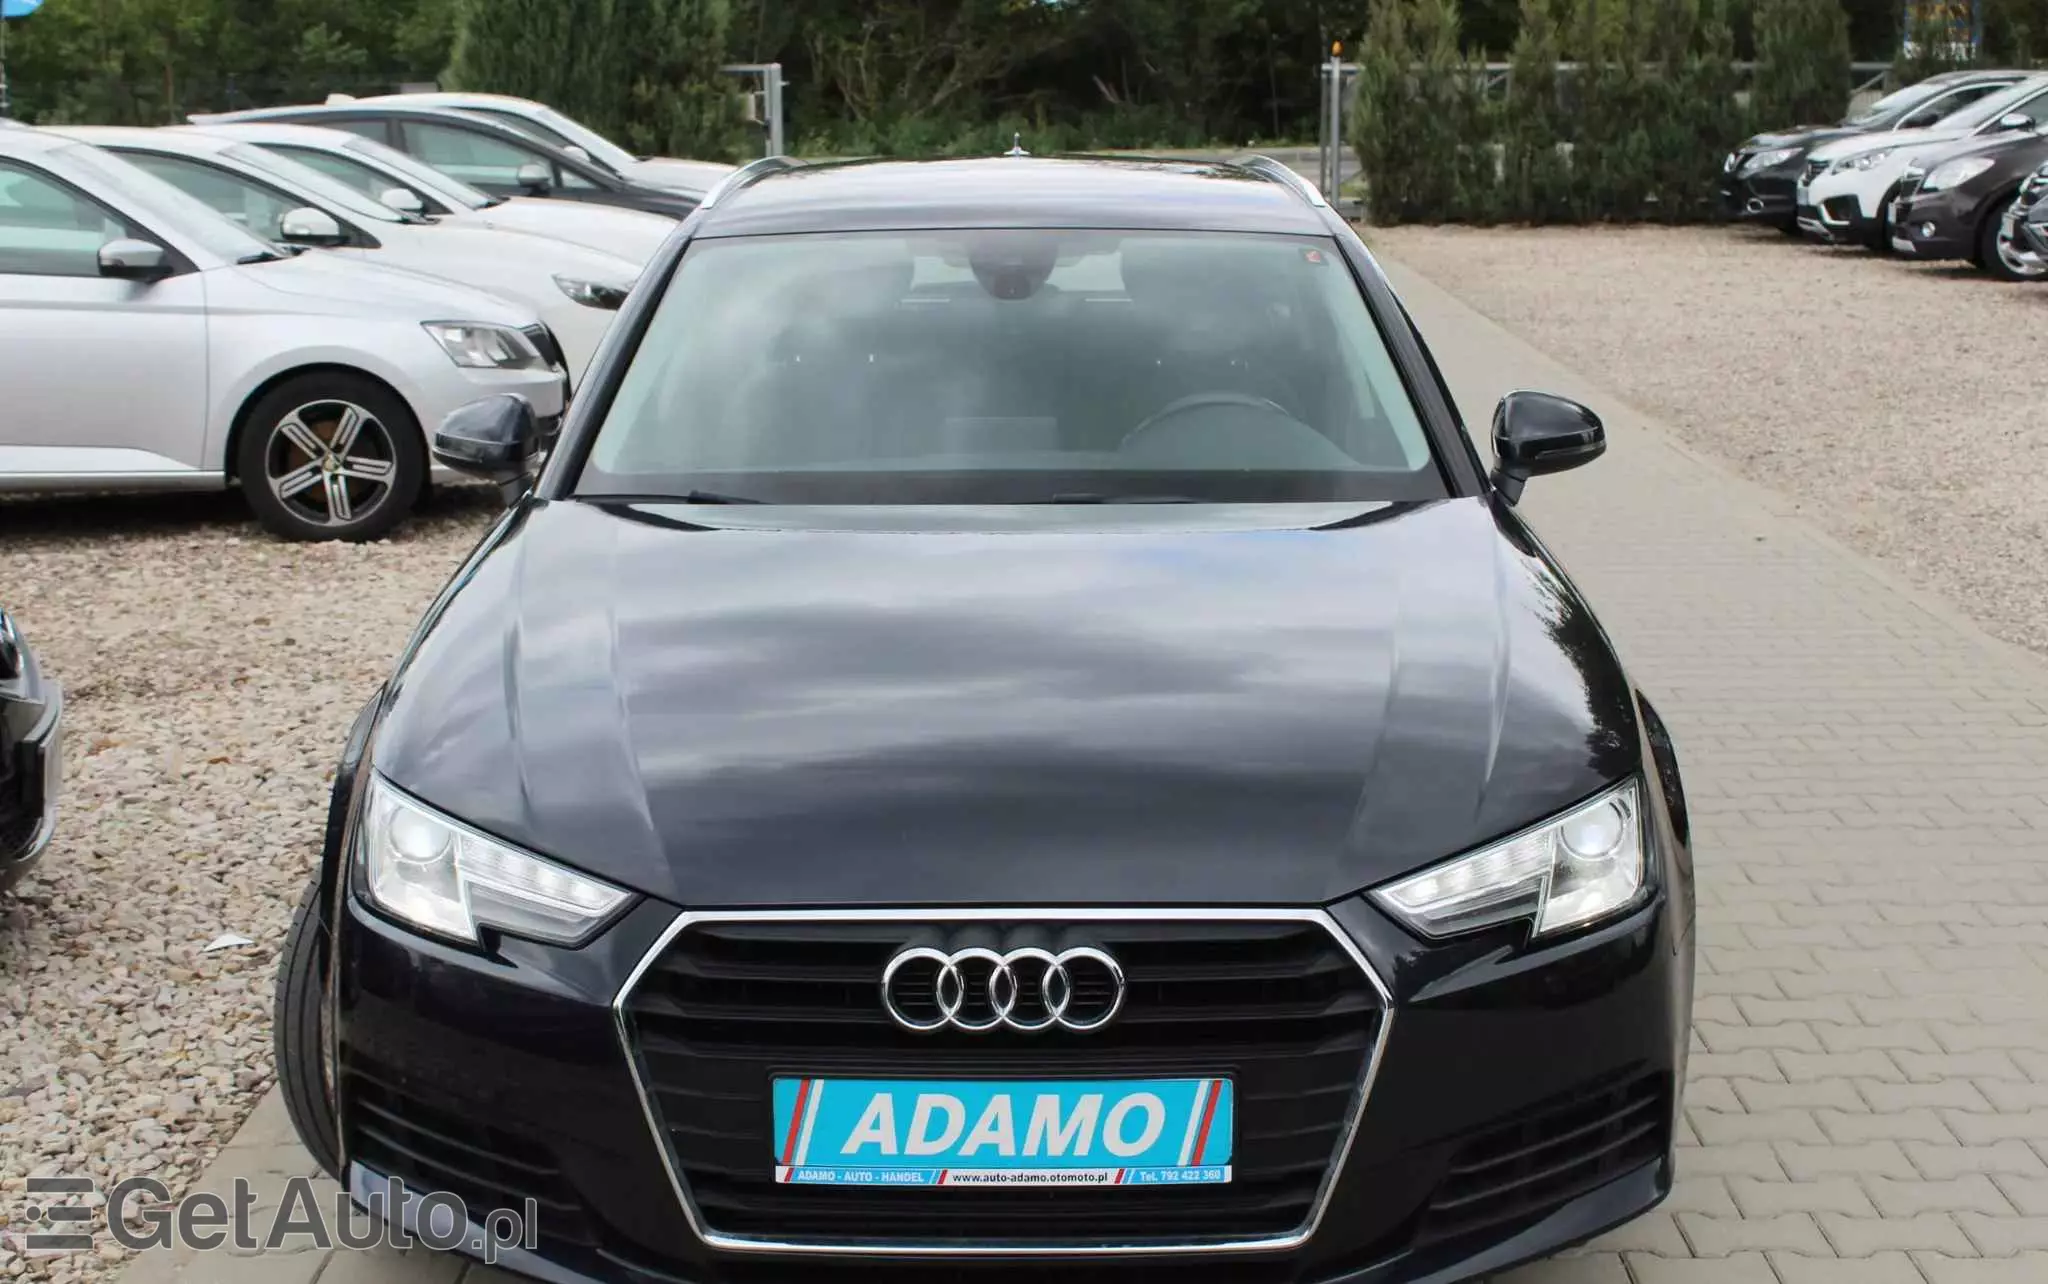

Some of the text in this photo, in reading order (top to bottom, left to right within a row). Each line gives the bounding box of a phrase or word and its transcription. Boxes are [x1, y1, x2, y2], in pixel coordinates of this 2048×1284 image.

[839, 1092, 1166, 1157] ADAMO
[797, 1172, 835, 1181] ADAMO
[844, 1172, 873, 1181] AUTO
[881, 1172, 924, 1182] HANDEL
[952, 1172, 1108, 1184] www.auto-adamo.otomoto.pl
[1161, 1171, 1178, 1180] 792
[1181, 1171, 1200, 1180] 422
